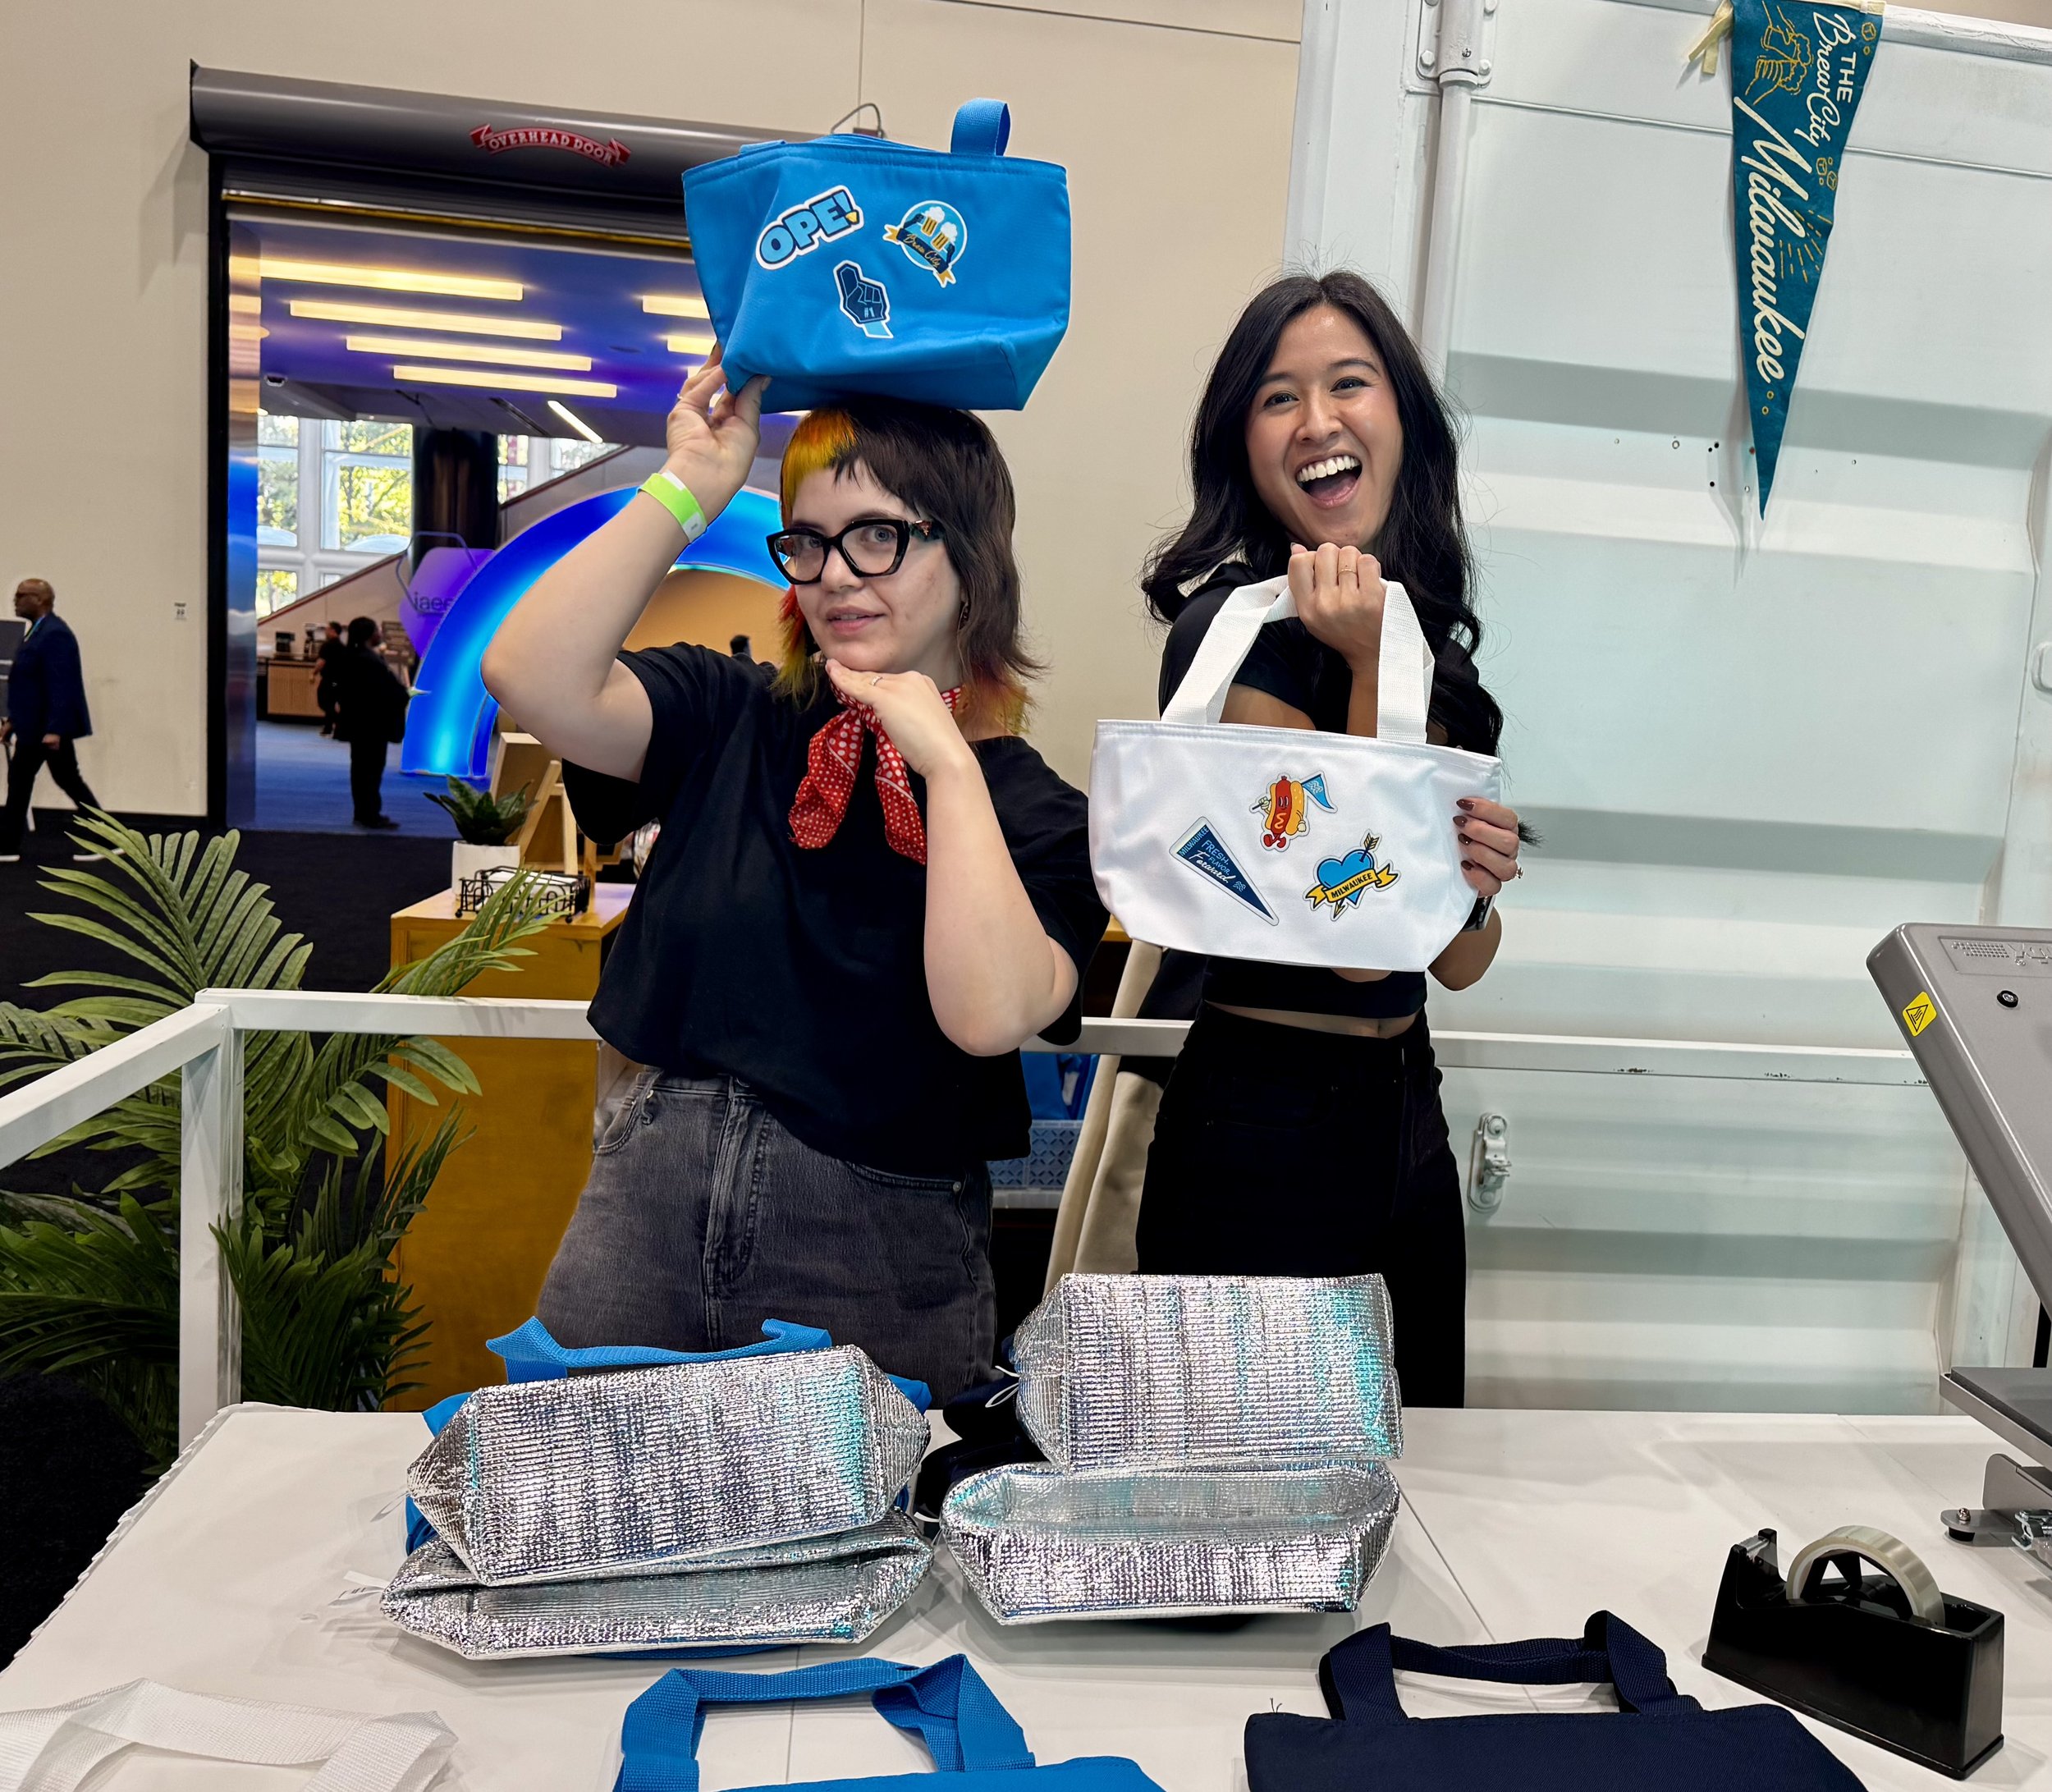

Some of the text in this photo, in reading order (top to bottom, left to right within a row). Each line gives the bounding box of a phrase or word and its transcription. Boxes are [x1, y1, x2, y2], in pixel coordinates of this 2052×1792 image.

[1793, 11, 1857, 147] Brew City
[1836, 51, 1857, 103] THE
[488, 131, 612, 164] OVERHEAD DOOR
[759, 188, 860, 264] OPE!
[1734, 96, 1813, 383] Milwaukee
[924, 250, 941, 268] City
[1179, 826, 1209, 856] MILWAUKEE
[1201, 839, 1229, 865] FRESH.
[1189, 850, 1236, 883] Forward.
[1208, 856, 1230, 875] FLAVOR.
[1331, 873, 1373, 899] MILWAUKEE
